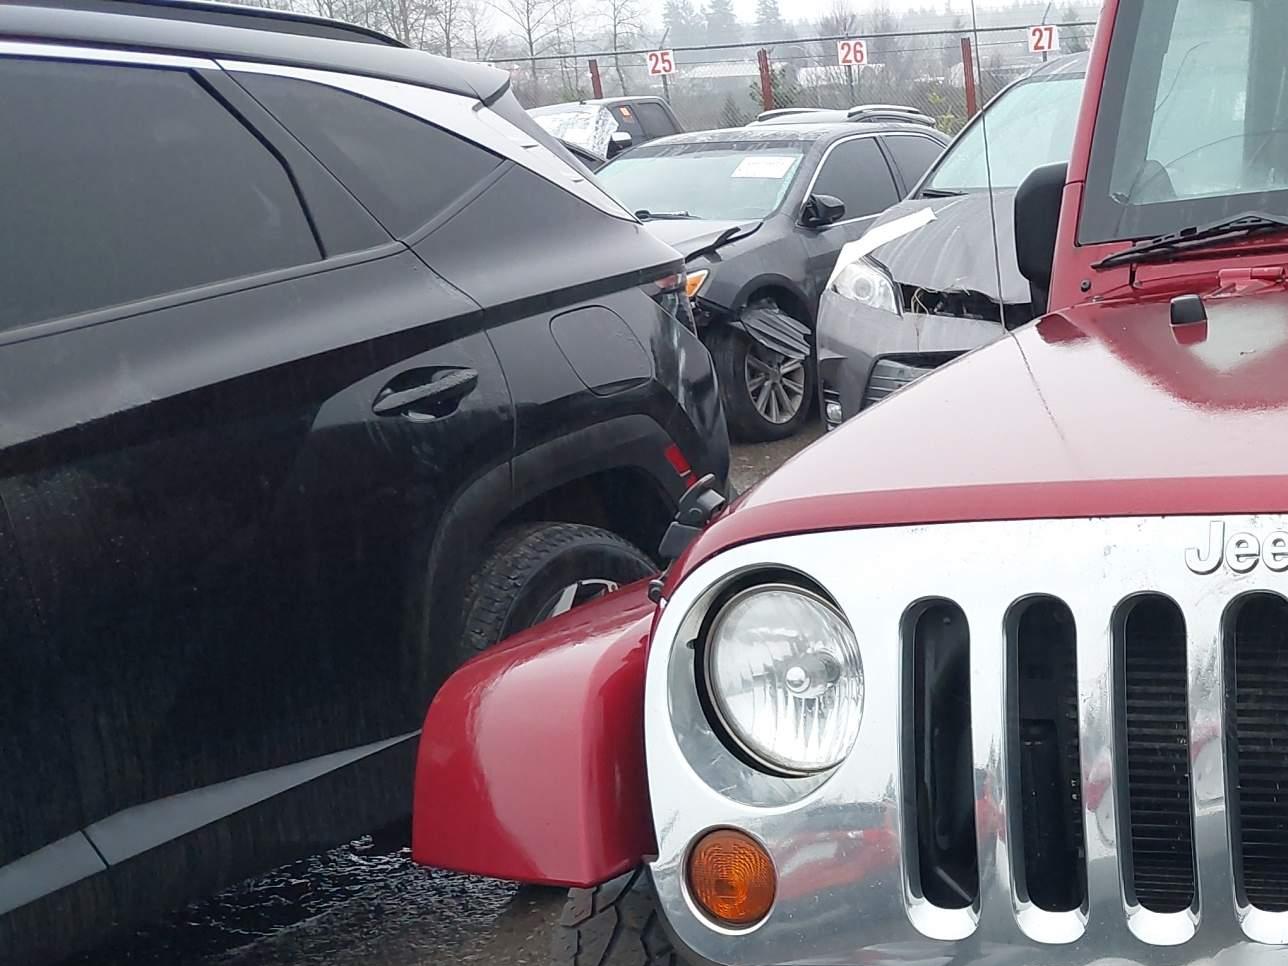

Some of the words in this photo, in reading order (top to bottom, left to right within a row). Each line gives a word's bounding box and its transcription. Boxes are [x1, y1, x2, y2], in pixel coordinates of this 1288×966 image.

[1032, 26, 1054, 52] 27
[649, 52, 673, 75] 25
[841, 41, 865, 65] 26
